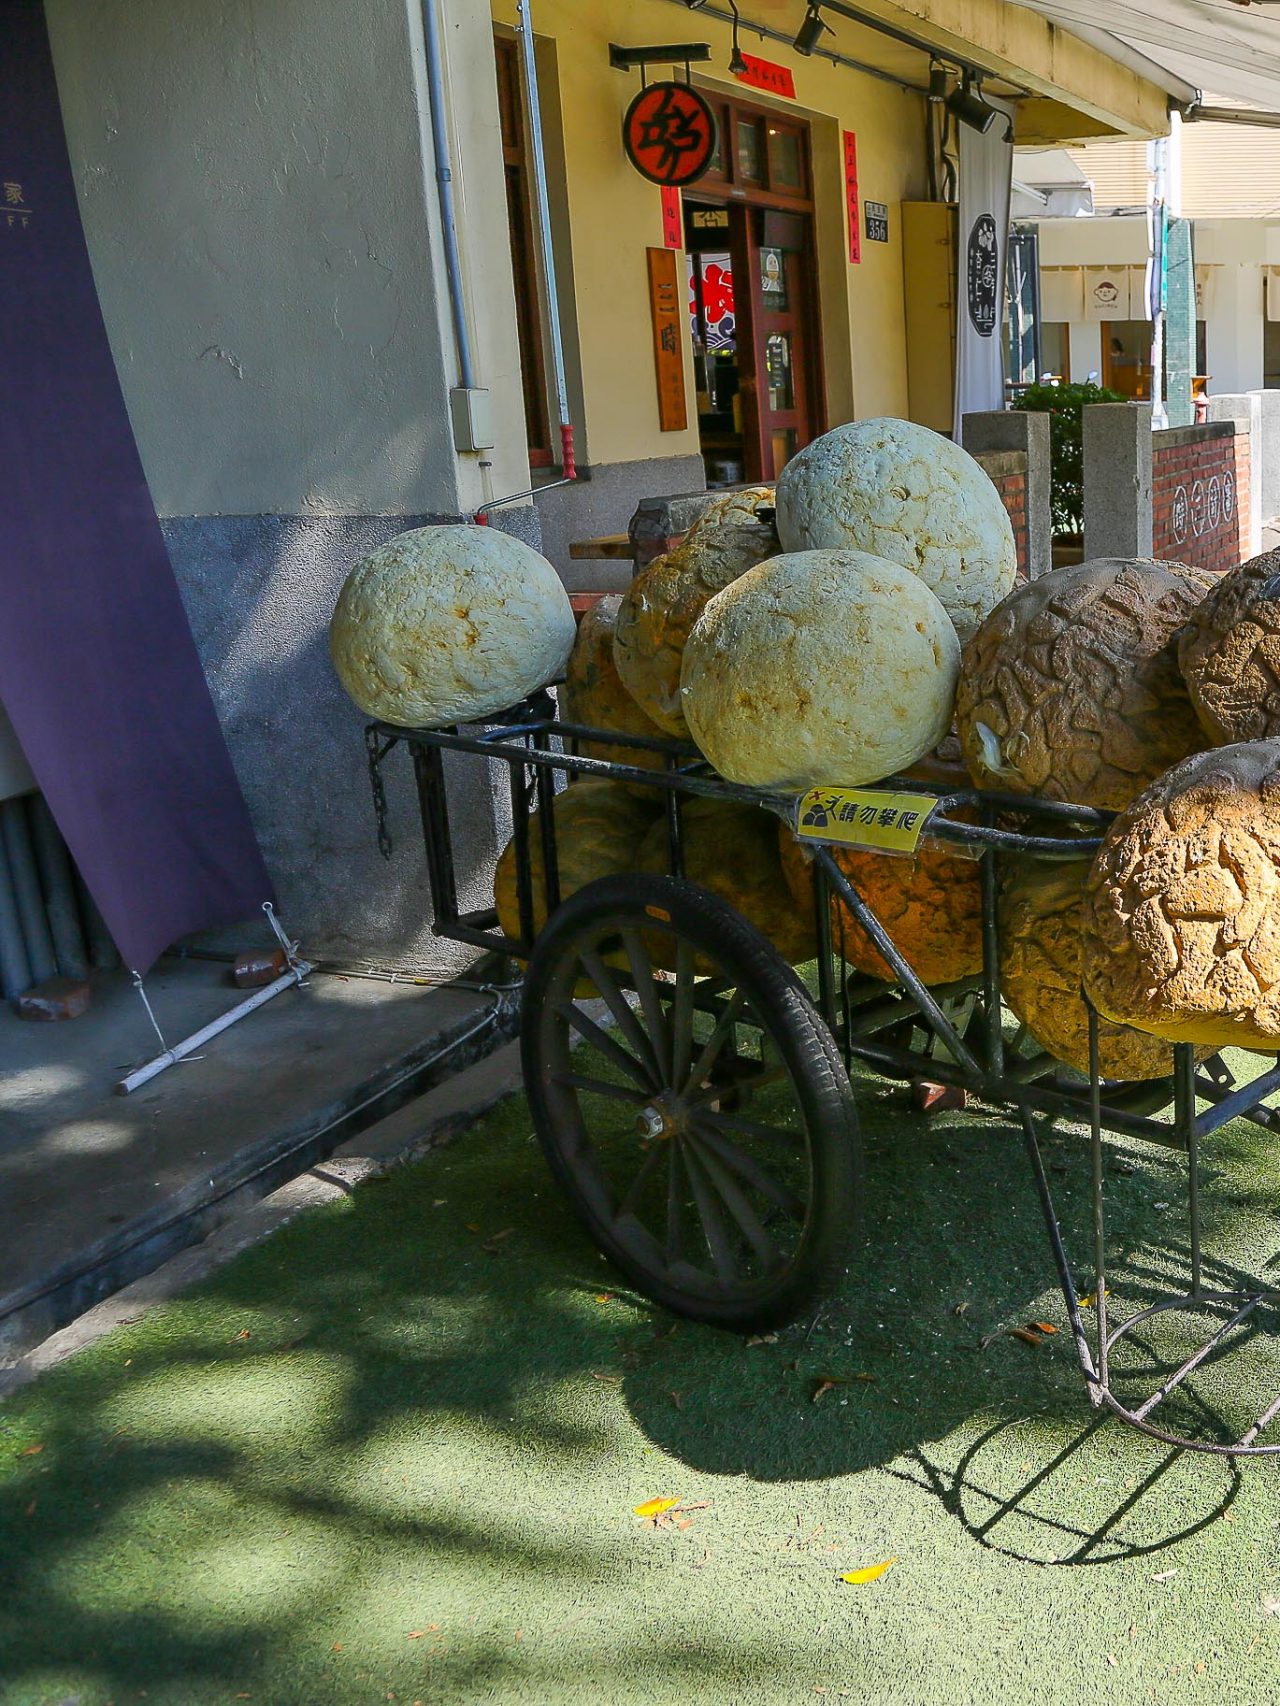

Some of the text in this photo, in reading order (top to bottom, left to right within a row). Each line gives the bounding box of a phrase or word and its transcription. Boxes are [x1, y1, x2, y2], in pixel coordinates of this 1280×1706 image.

[869, 219, 886, 241] 356
[839, 802, 920, 831] 請勿攀爬
